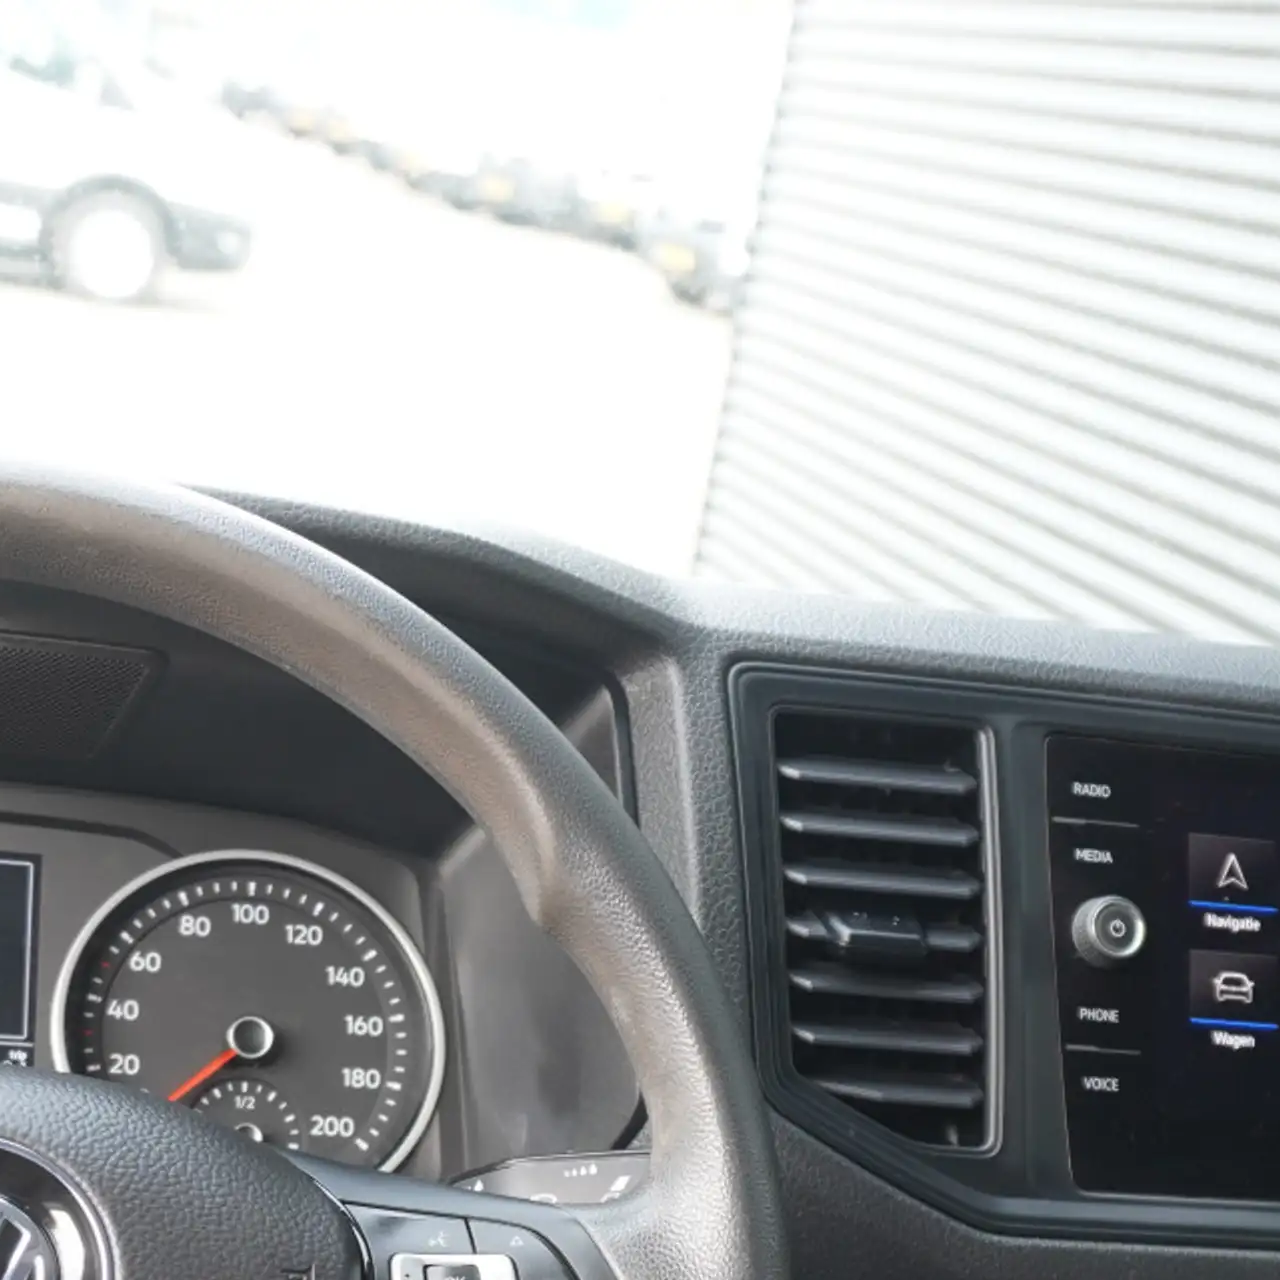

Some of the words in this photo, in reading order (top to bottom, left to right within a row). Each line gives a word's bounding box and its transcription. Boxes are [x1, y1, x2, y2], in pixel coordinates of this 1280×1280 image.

[1072, 782, 1111, 798] RADIO
[1074, 848, 1113, 864] MEDIA
[231, 904, 270, 926] 100
[1204, 914, 1261, 932] Navigatie
[180, 916, 211, 938] 80
[285, 924, 323, 947] 120
[129, 952, 162, 973] 60
[326, 966, 365, 987] 140
[107, 1000, 139, 1021] 40
[1078, 1007, 1120, 1023] PHONE
[345, 1015, 383, 1037] 160
[1211, 1031, 1255, 1050] Wagen
[109, 1054, 140, 1075] 20
[342, 1068, 380, 1089] 180
[1082, 1076, 1120, 1092] VOICE
[235, 1096, 255, 1109] 1/2
[310, 1116, 354, 1138] 200
